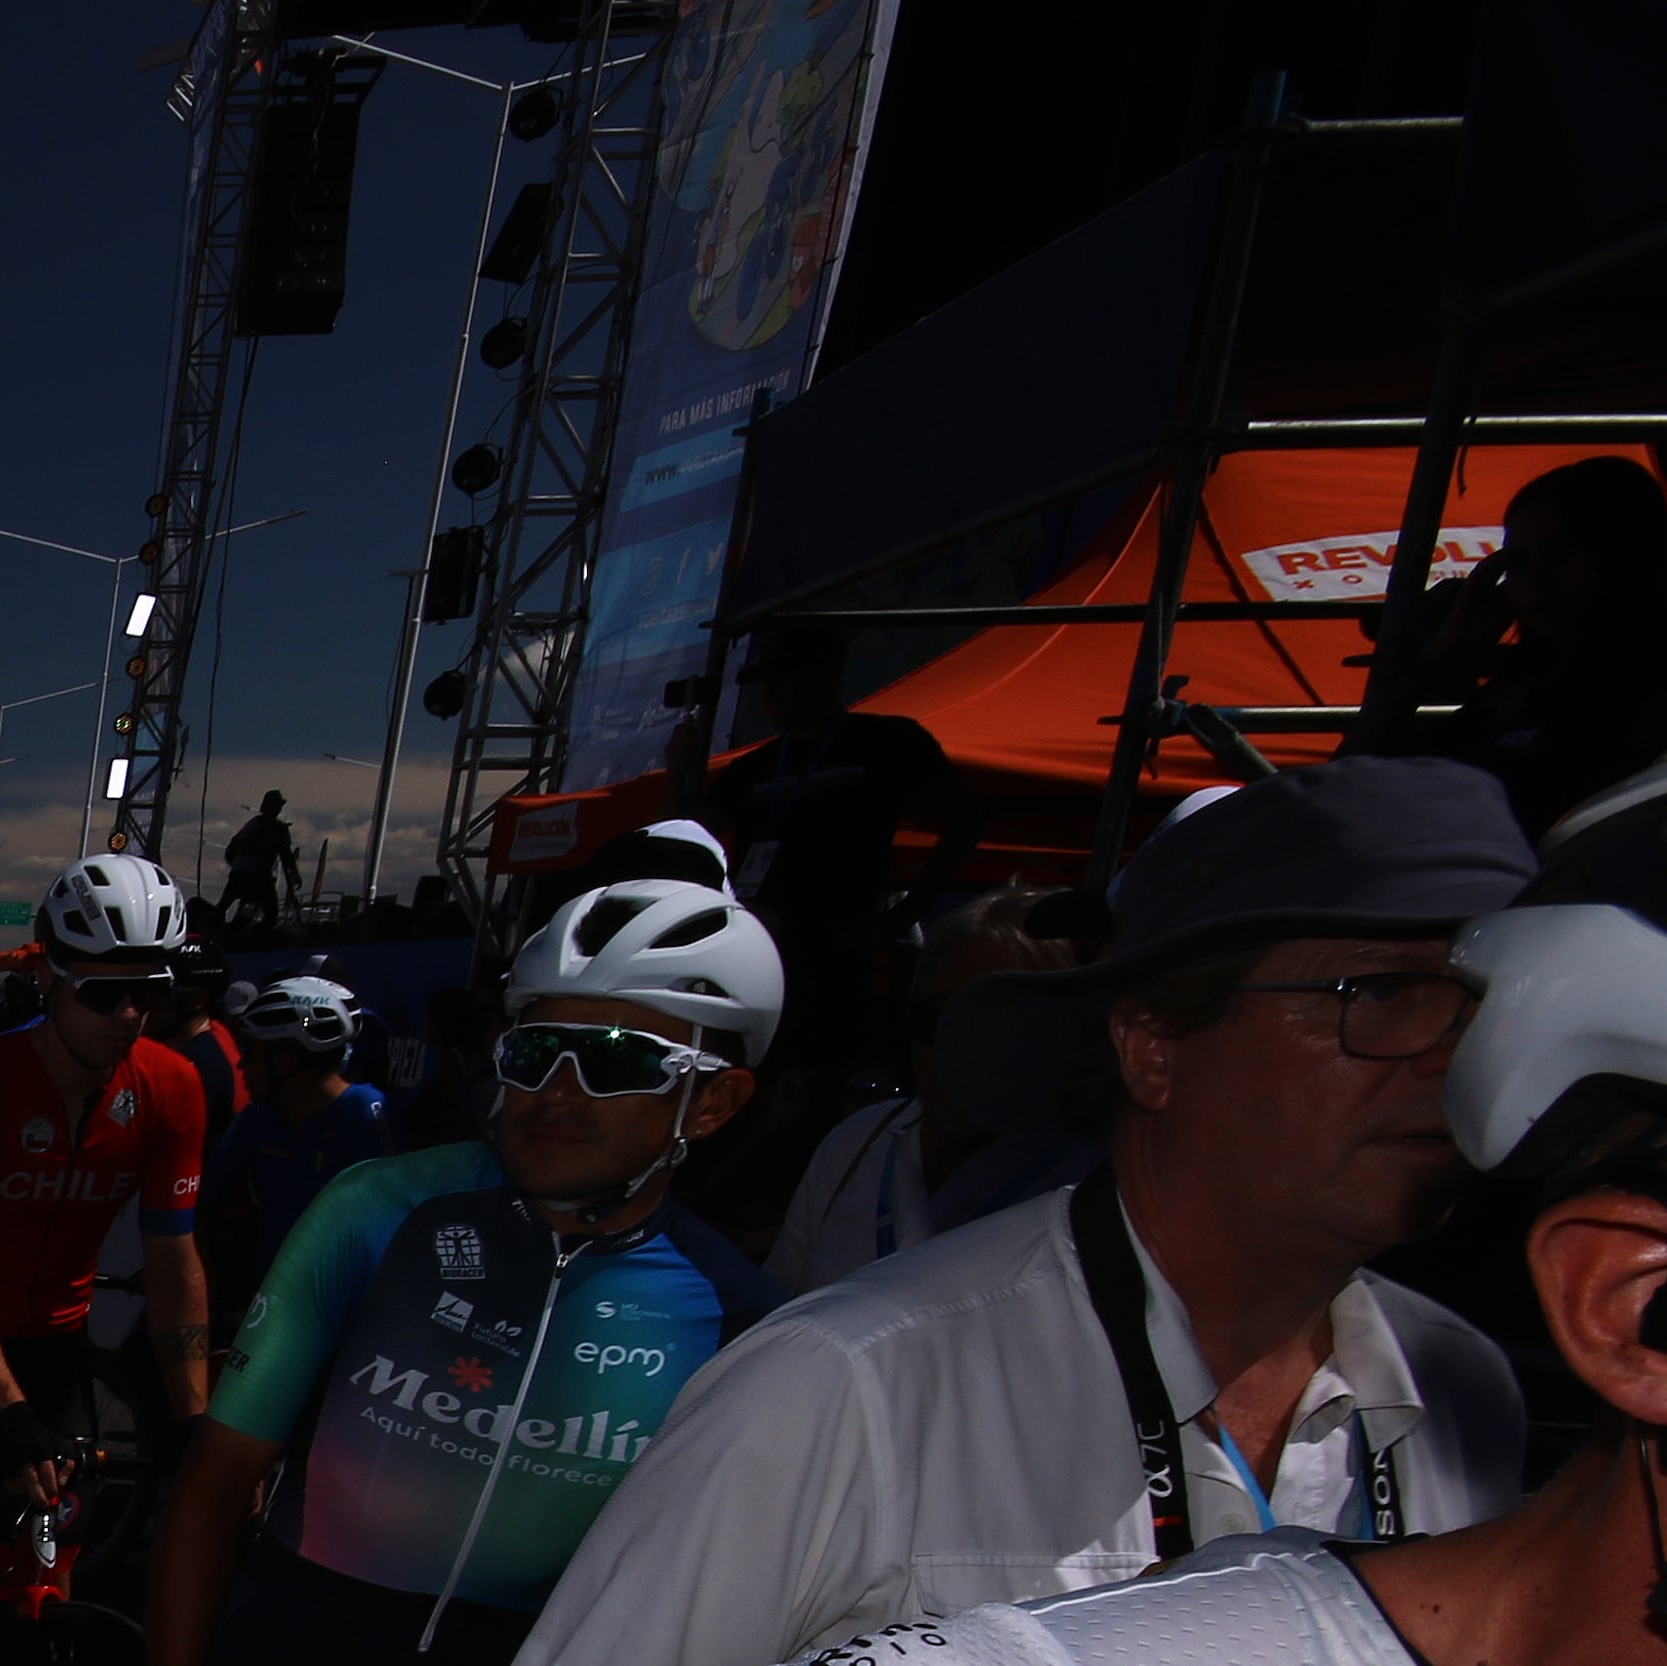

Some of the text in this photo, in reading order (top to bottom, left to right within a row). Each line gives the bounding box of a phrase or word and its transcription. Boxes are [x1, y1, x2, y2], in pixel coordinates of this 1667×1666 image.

[0, 1168, 139, 1202] CHILE
[573, 1340, 666, 1378] epm
[429, 1429, 494, 1467] todo
[507, 1453, 613, 1488] florece
